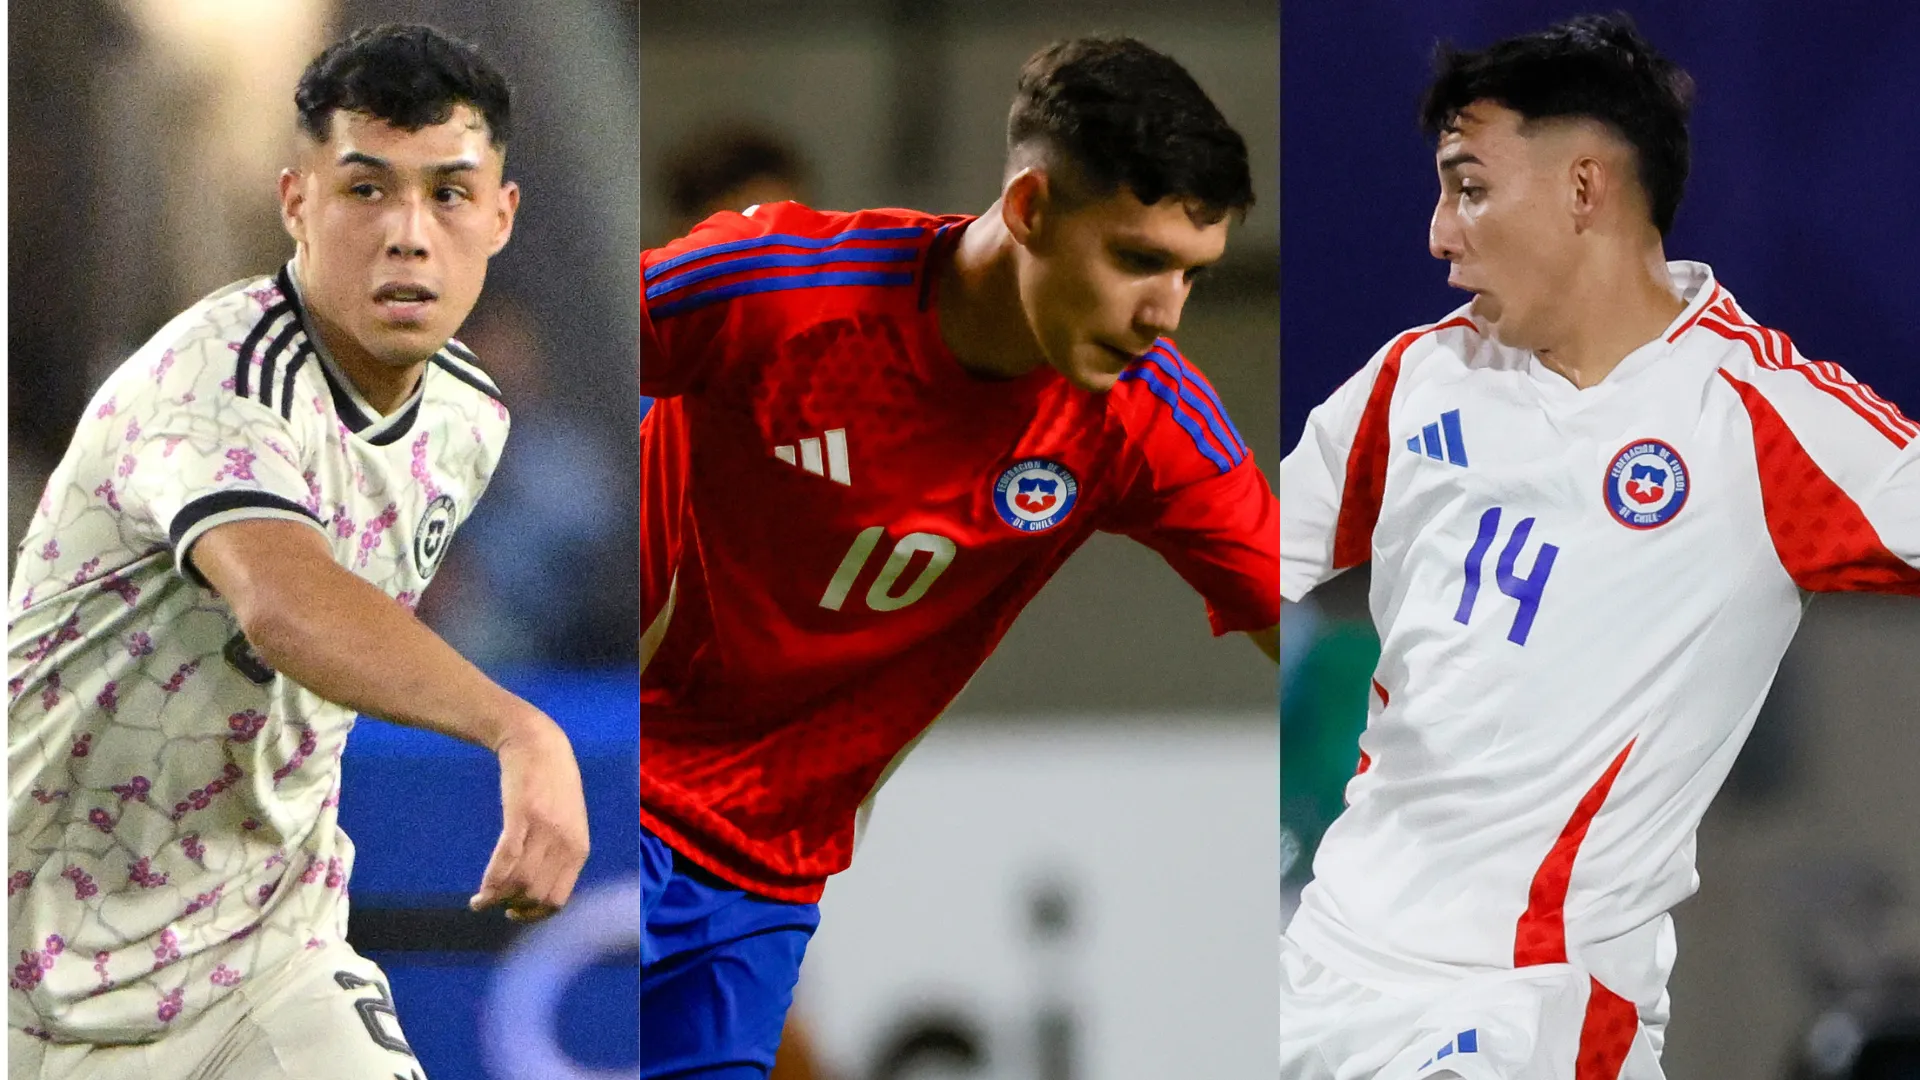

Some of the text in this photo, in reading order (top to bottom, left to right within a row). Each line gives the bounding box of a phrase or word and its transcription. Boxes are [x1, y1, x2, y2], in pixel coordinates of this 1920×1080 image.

[1659, 447, 1671, 460] DE
[1047, 462, 1059, 473] DE
[1618, 506, 1659, 523] DE CHILE
[1012, 518, 1055, 531] DE CHILE
[818, 526, 957, 612] 10
[1453, 506, 1560, 647] 14
